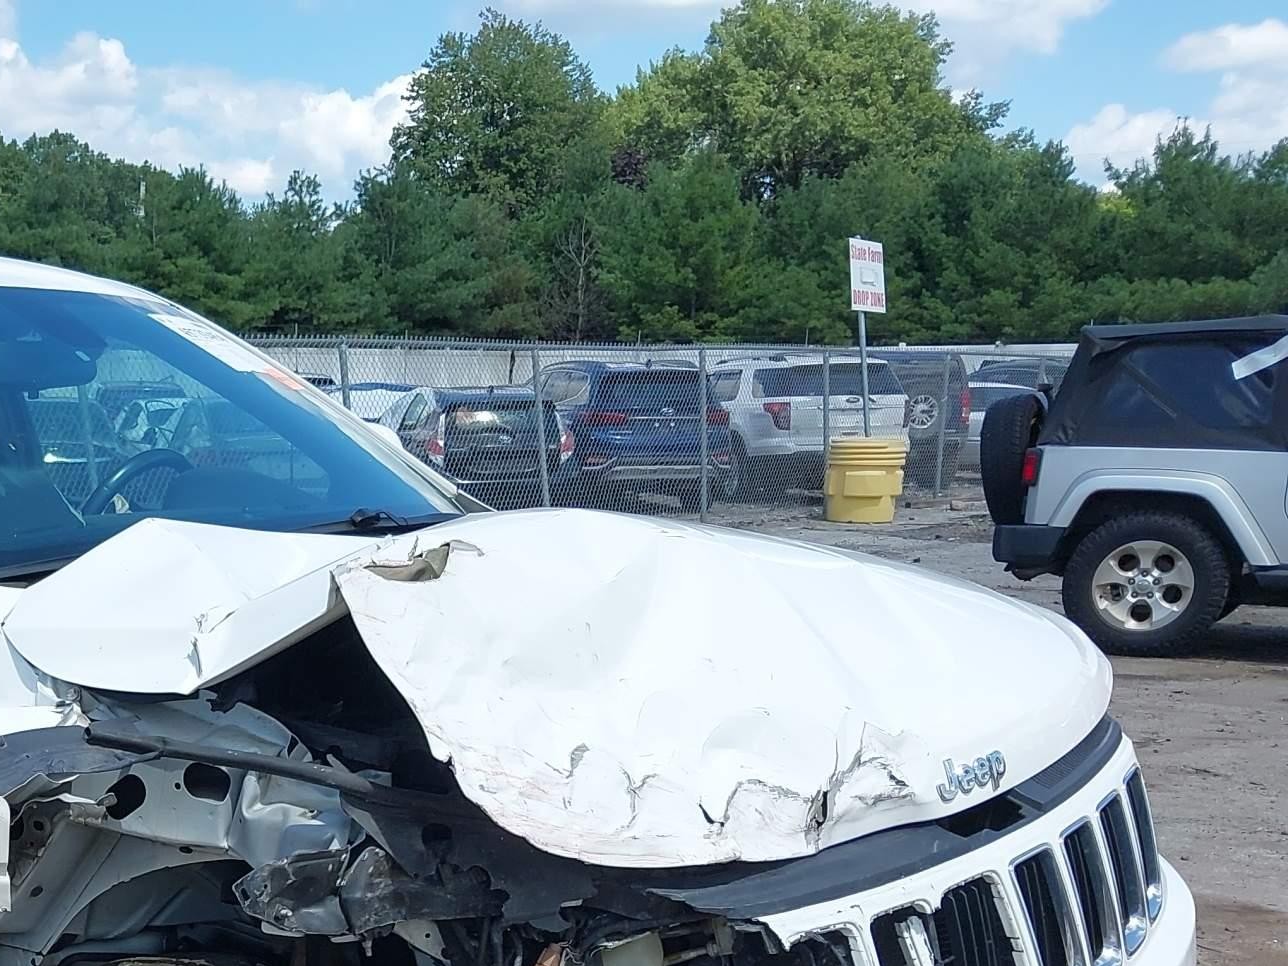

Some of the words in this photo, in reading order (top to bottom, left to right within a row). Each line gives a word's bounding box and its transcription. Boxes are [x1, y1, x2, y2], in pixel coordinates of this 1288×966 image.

[850, 243, 867, 261] State
[868, 247, 882, 264] Farm
[853, 289, 869, 305] DROP
[870, 292, 884, 308] ZONE
[936, 750, 1007, 803] Jeep
